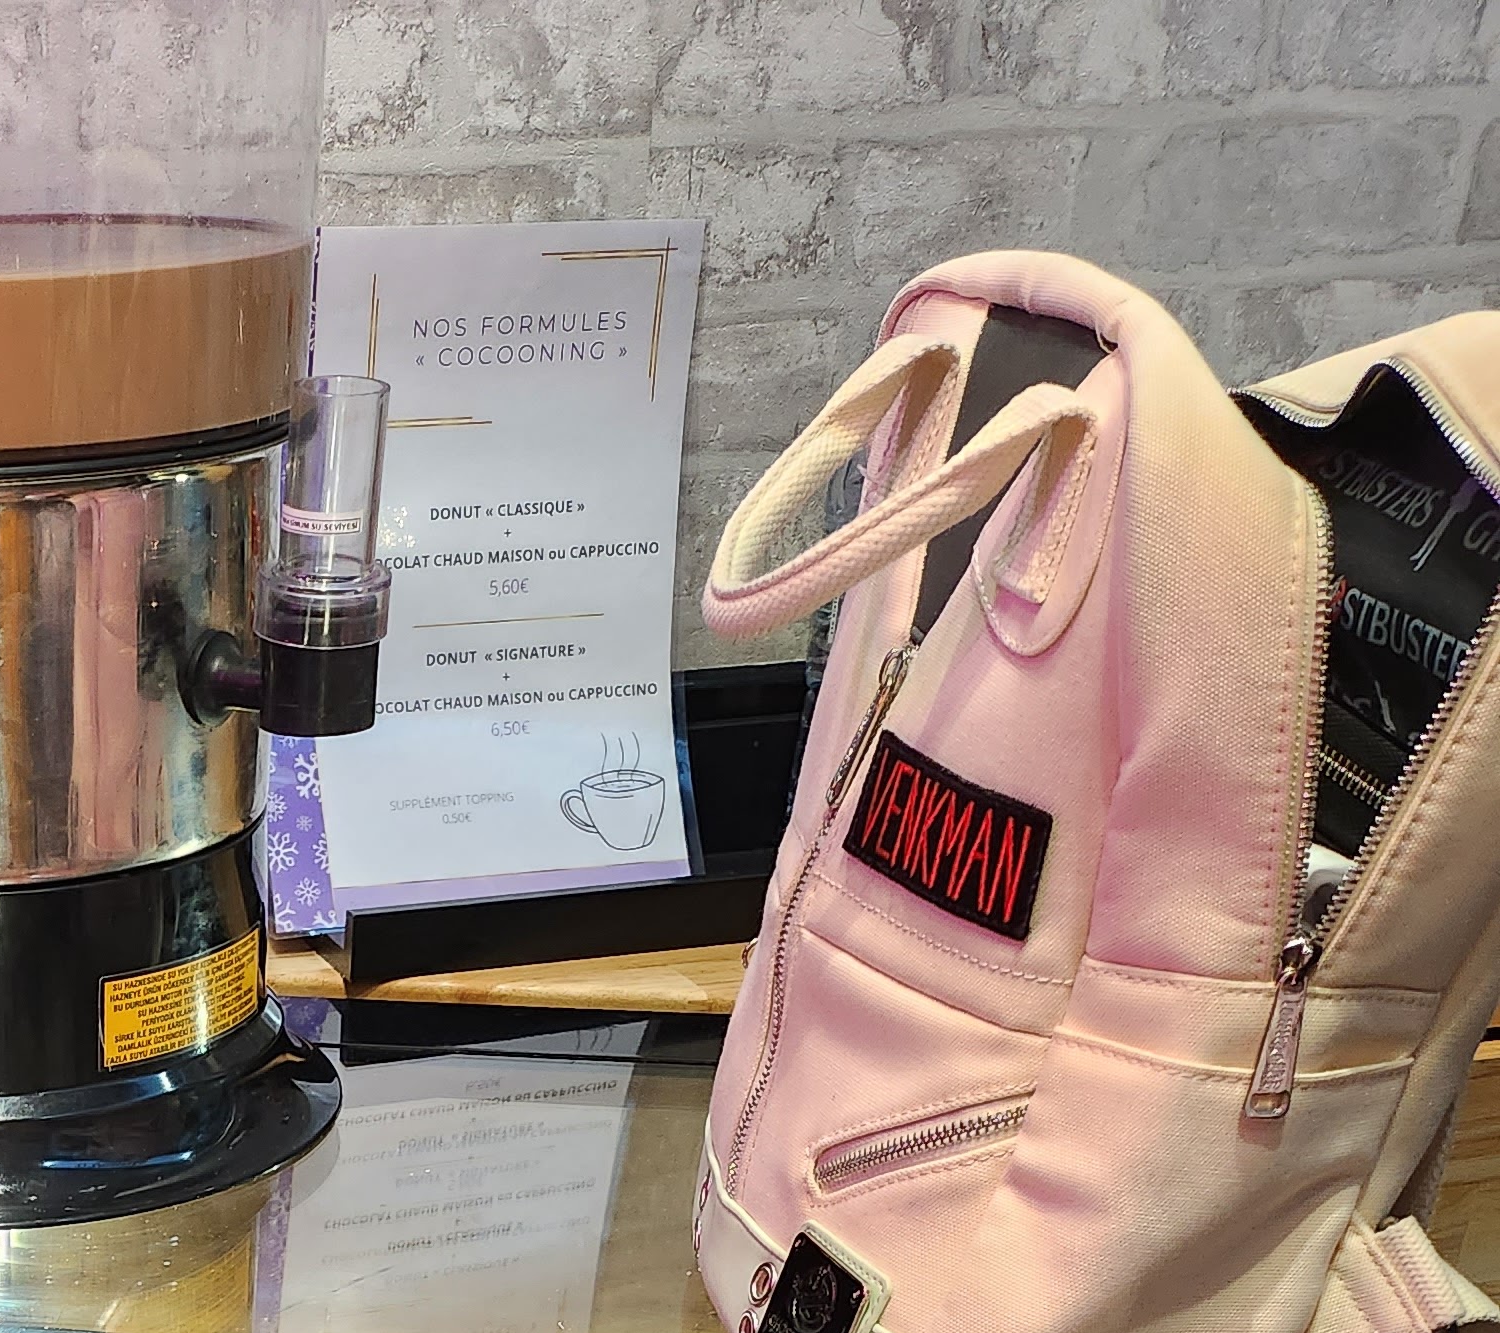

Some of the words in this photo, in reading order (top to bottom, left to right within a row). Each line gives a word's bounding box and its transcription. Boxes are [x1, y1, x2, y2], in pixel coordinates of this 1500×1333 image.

[413, 317, 467, 339] NOS
[481, 311, 627, 336] FORMULES
[438, 341, 605, 367] COCOONING
[430, 505, 481, 521] DONUT
[497, 500, 573, 517] CLASSIQUE
[434, 553, 483, 567] CHAUD
[487, 548, 544, 564] MAISON
[548, 550, 566, 560] ou
[570, 541, 659, 559] CAPPUCCINO
[489, 578, 529, 597] 5,60€
[426, 651, 477, 666] DONUT
[496, 644, 574, 661] SIGNATURE
[375, 699, 431, 715] OCOLAT
[434, 696, 483, 711] CHAUD
[487, 691, 543, 707] MAISON
[547, 691, 565, 702] ou
[568, 682, 658, 701] CAPPUCCINO
[491, 720, 531, 738] 6,50€
[389, 795, 462, 811] SUPPLÉMENT
[465, 792, 515, 805] TOPPING
[861, 747, 1032, 924] VENKMAN
[112, 983, 122, 991] SU
[168, 970, 177, 979] SU
[138, 1009, 147, 1018] SU
